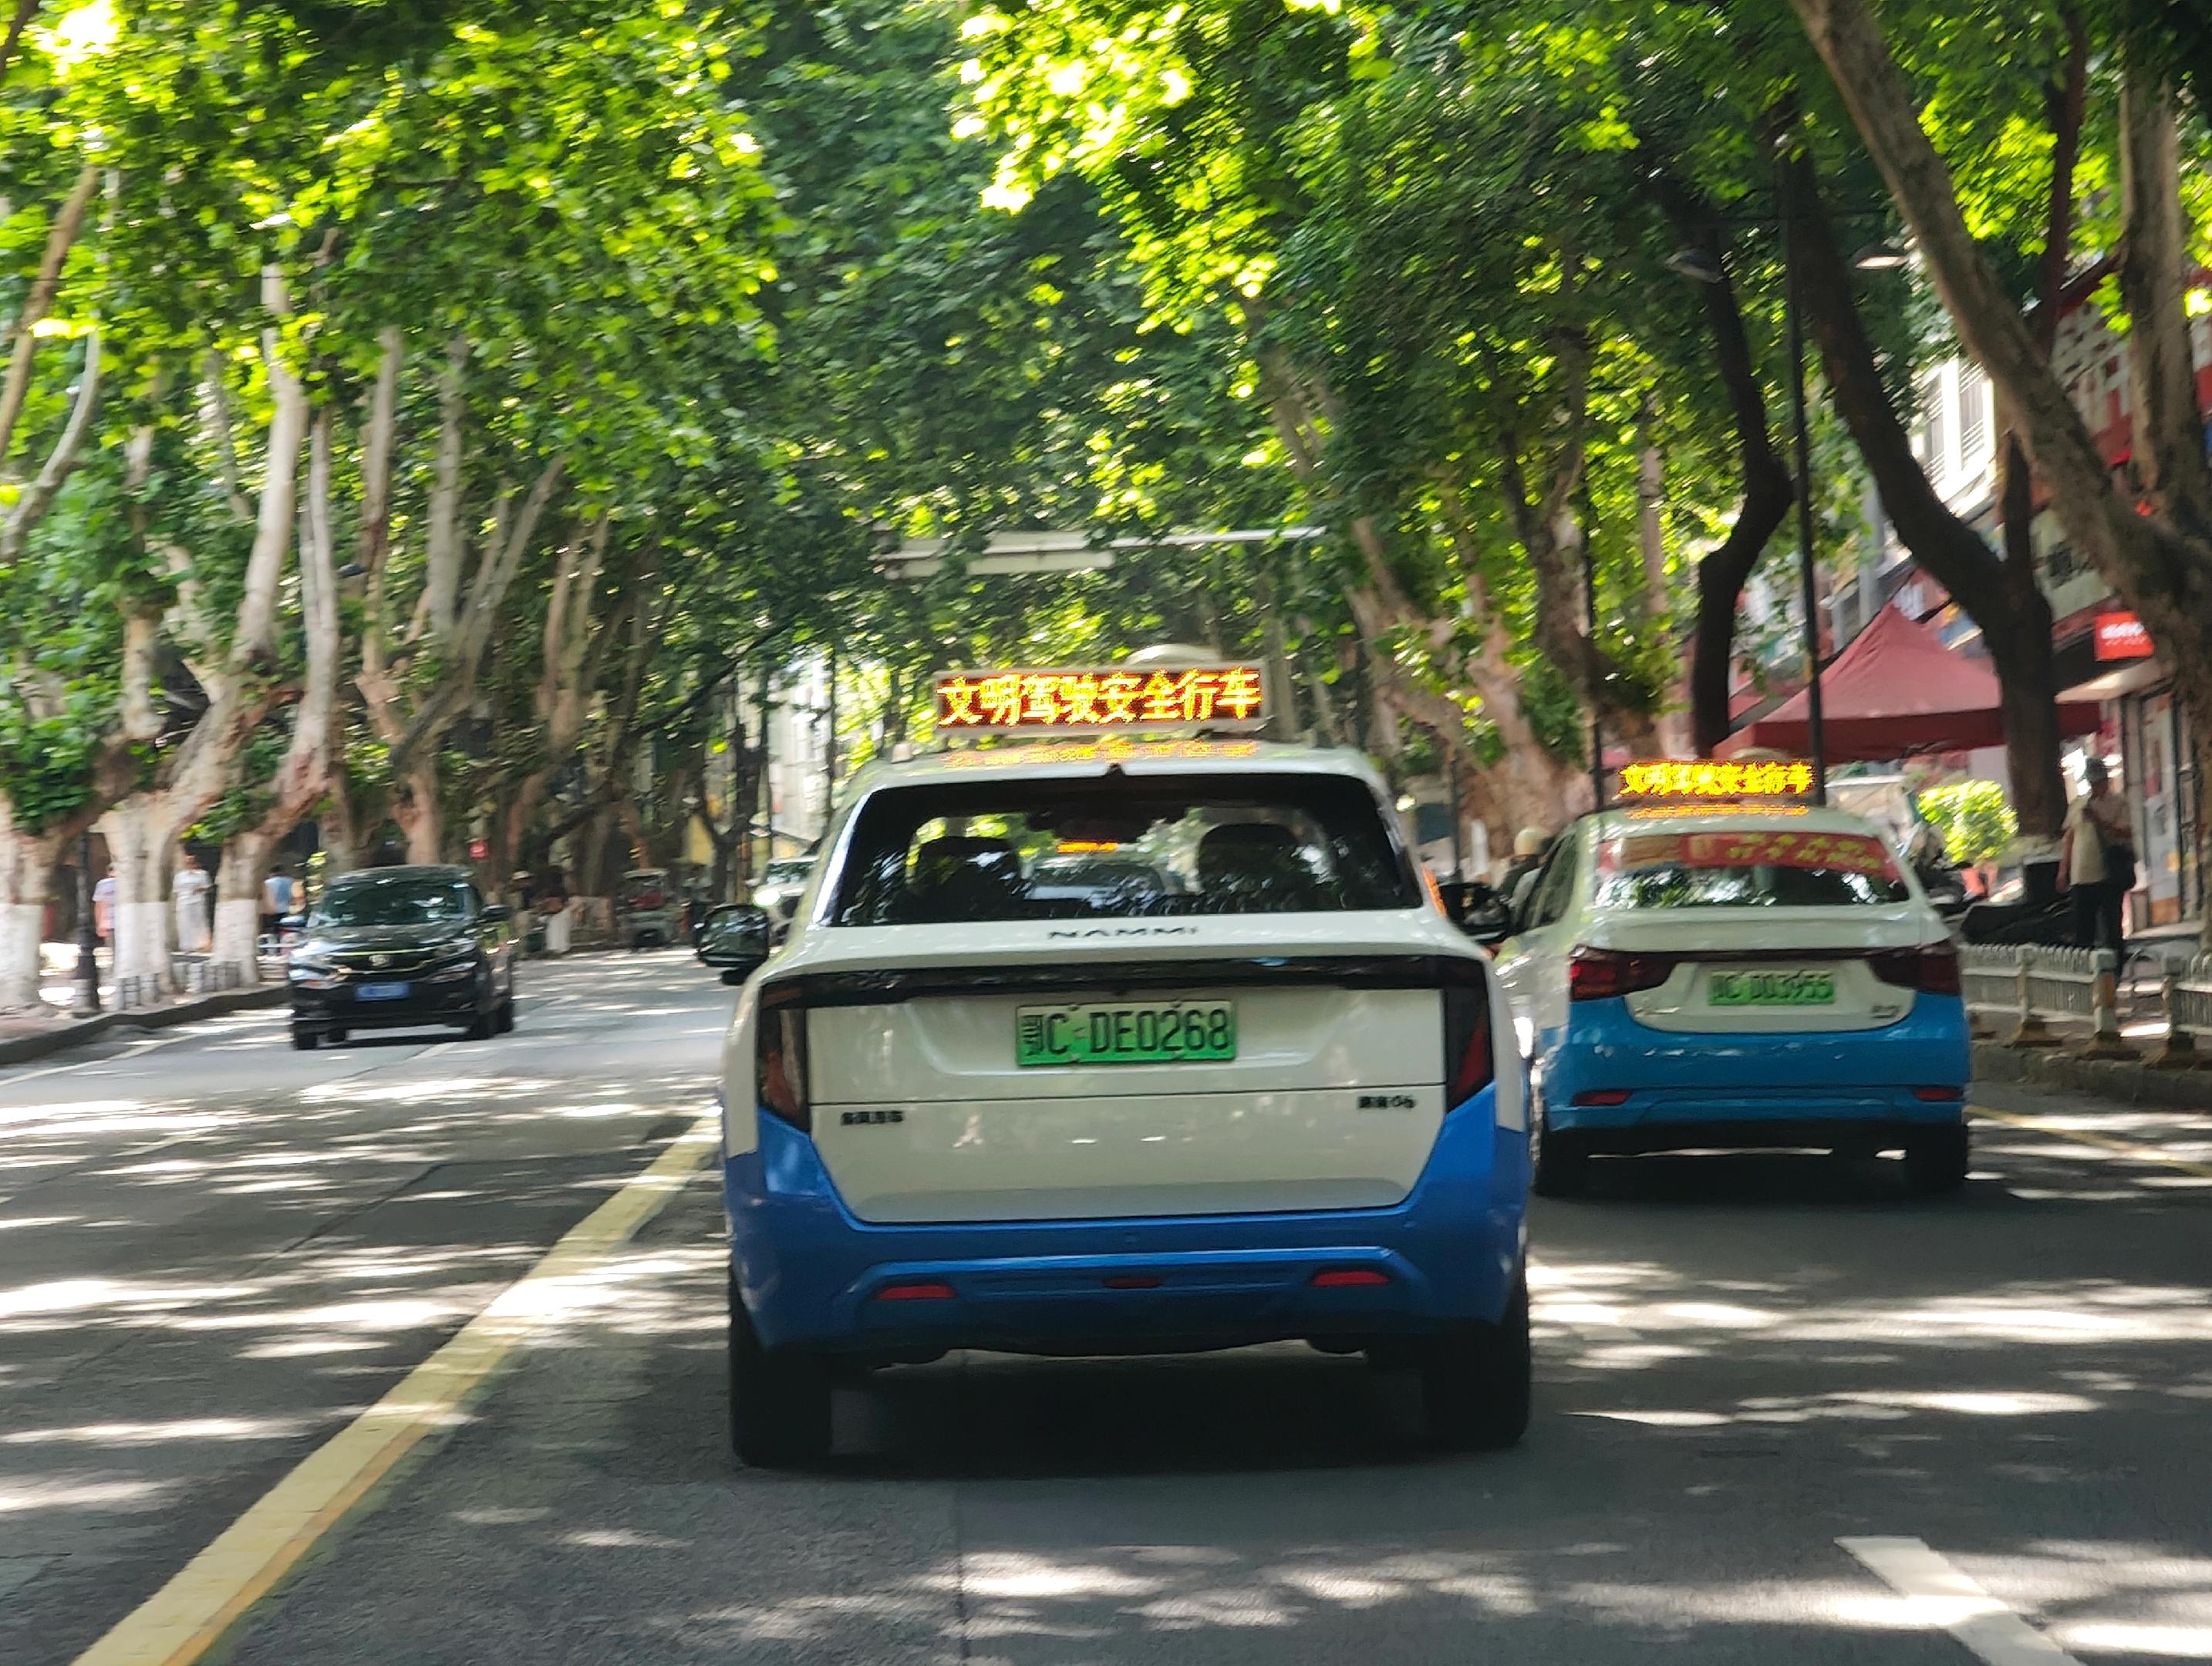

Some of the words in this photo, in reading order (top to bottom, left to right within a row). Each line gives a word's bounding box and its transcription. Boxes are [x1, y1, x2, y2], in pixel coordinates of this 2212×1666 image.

[936, 666, 1263, 726] 文明驾驶安全行车
